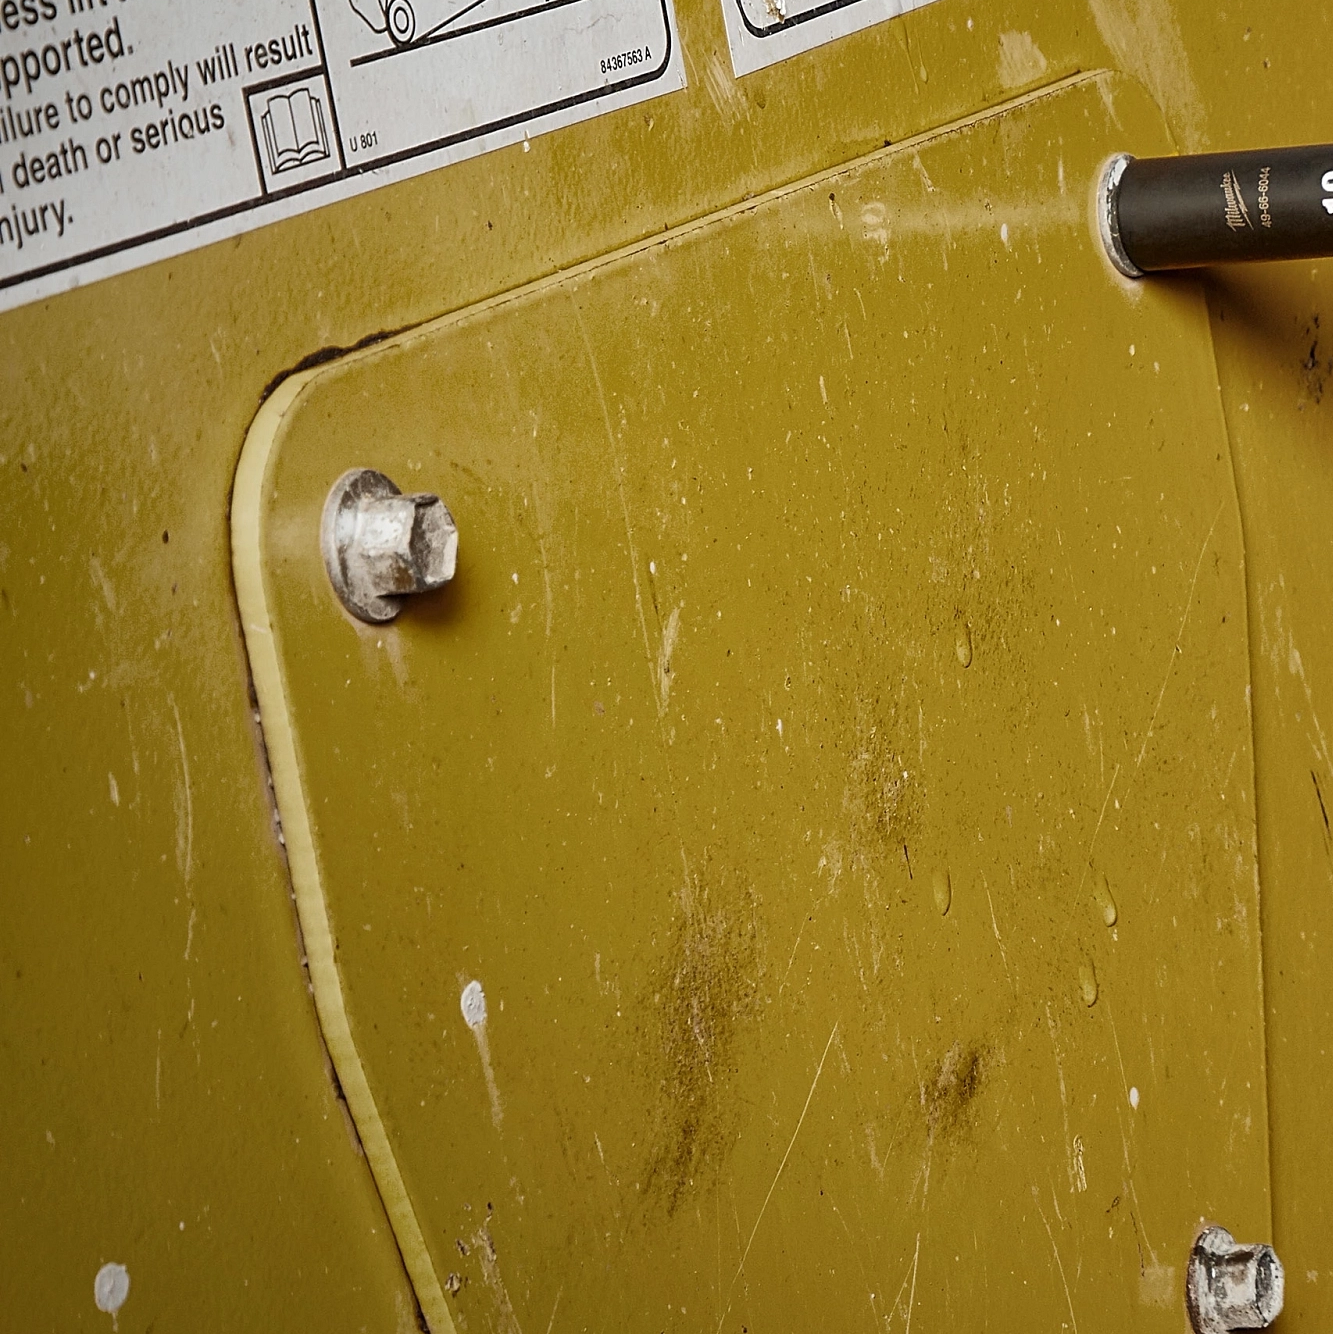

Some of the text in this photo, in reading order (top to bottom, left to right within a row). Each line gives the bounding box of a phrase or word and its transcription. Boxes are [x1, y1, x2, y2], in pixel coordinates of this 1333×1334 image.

[65, 90, 93, 123] to
[100, 60, 189, 114] comply
[196, 42, 239, 86] will
[244, 23, 313, 73] result
[600, 45, 652, 74] 84367563 A
[11, 136, 88, 189] death
[95, 131, 121, 165] or
[130, 102, 225, 154] serious
[349, 131, 379, 152] U 801
[1220, 171, 1246, 232] Milwaukee
[1257, 167, 1272, 228] 49-66-6044
